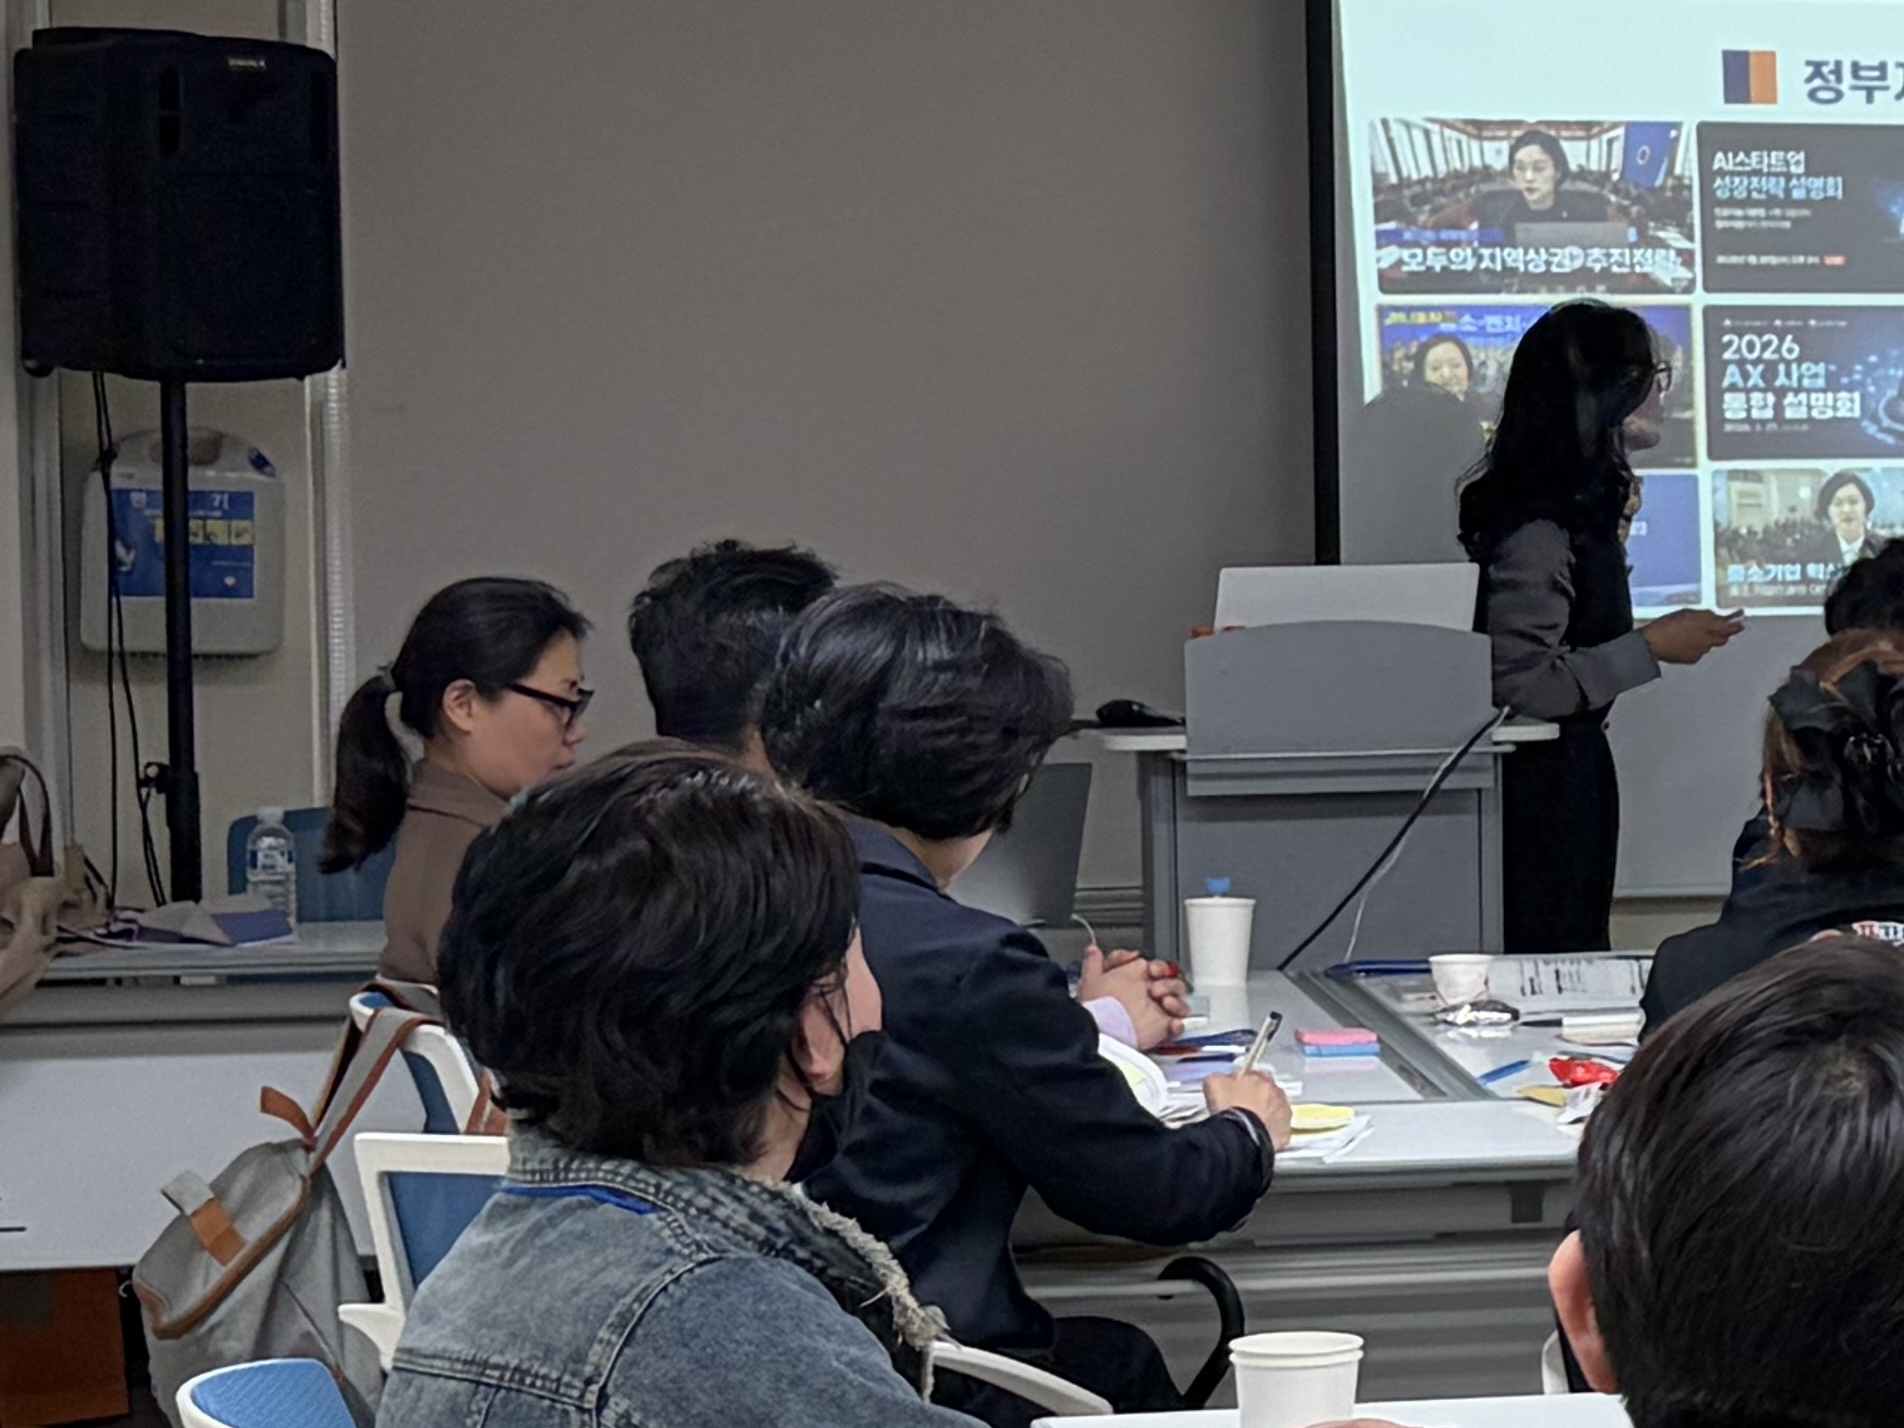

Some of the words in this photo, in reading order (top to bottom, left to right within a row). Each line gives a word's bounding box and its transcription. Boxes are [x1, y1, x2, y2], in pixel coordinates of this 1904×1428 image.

[1712, 151, 1806, 173] AI스타트업
[1789, 176, 1844, 200] 설명회
[1401, 247, 1473, 272] 모두의
[1721, 334, 1800, 360] 2026
[1722, 364, 1765, 389] AX
[1774, 362, 1826, 389] 사업
[1783, 391, 1861, 419] 설명회
